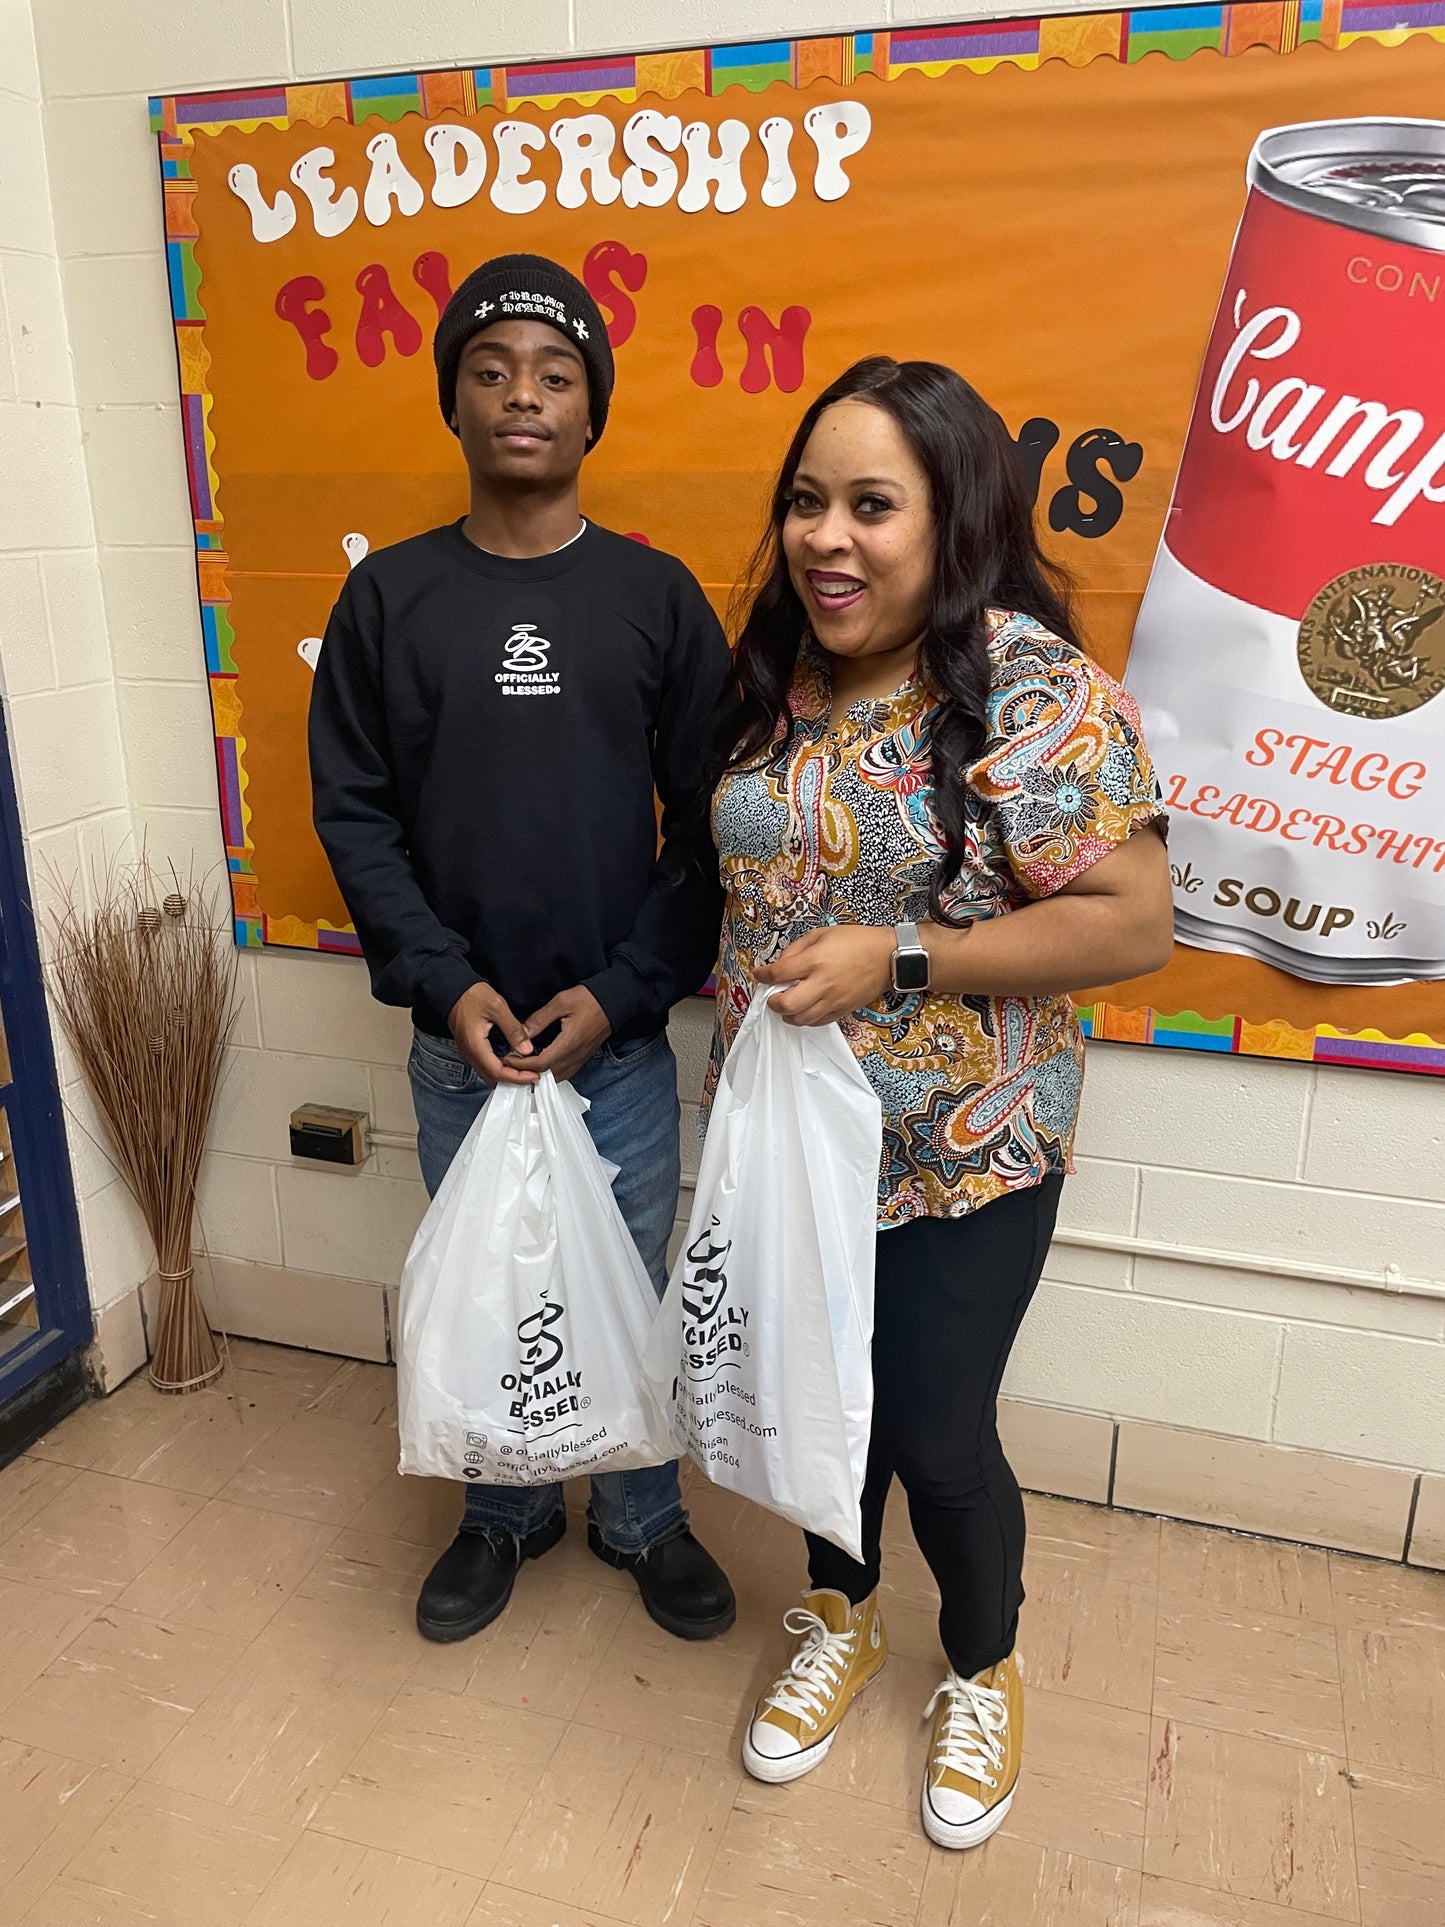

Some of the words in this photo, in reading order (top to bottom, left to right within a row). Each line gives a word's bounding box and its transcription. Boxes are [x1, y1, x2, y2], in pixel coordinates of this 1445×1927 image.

[227, 101, 872, 243] LEADERSHIP
[1346, 256, 1440, 302] CON
[275, 240, 648, 381] FAIS
[690, 305, 812, 393] IN
[494, 672, 560, 683] OFFICIALLY
[1245, 728, 1427, 800] STAGG
[1213, 878, 1354, 938] SOUP
[709, 1450, 740, 1469] 60604
